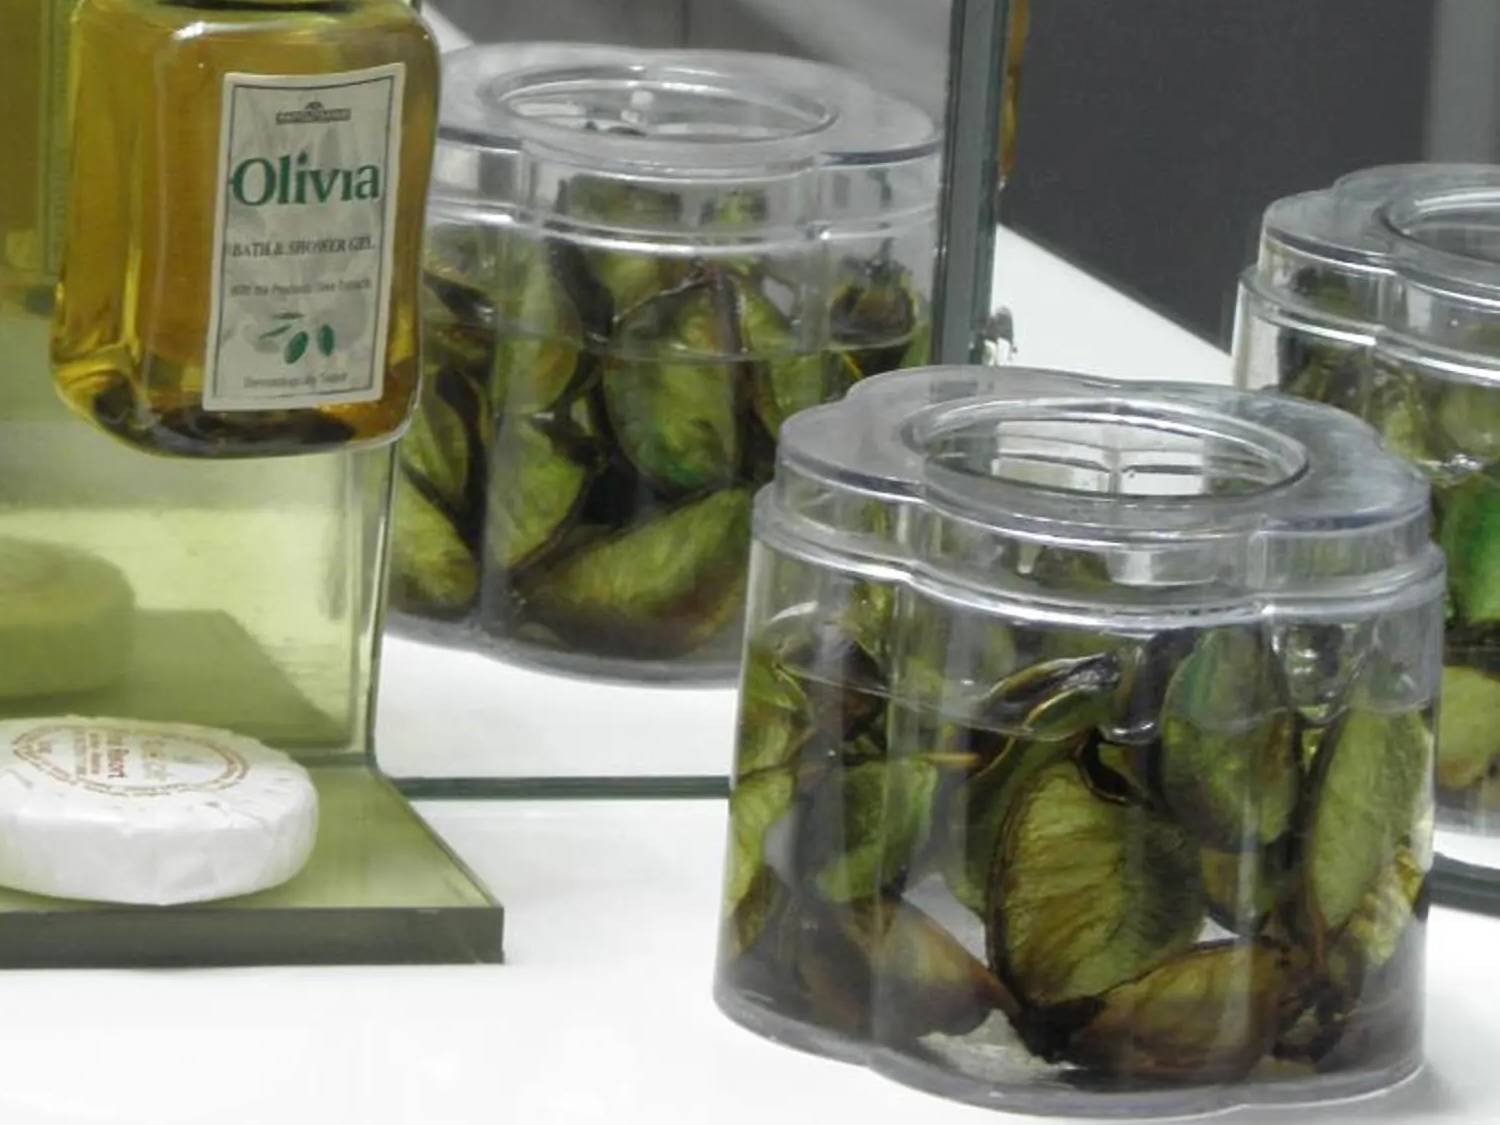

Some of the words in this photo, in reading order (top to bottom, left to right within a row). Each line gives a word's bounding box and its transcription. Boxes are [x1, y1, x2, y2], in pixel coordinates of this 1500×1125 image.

[232, 150, 380, 206] Olivia
[232, 242, 270, 257] BATH
[288, 238, 346, 255] SHOWER
[348, 236, 374, 251] GEL
